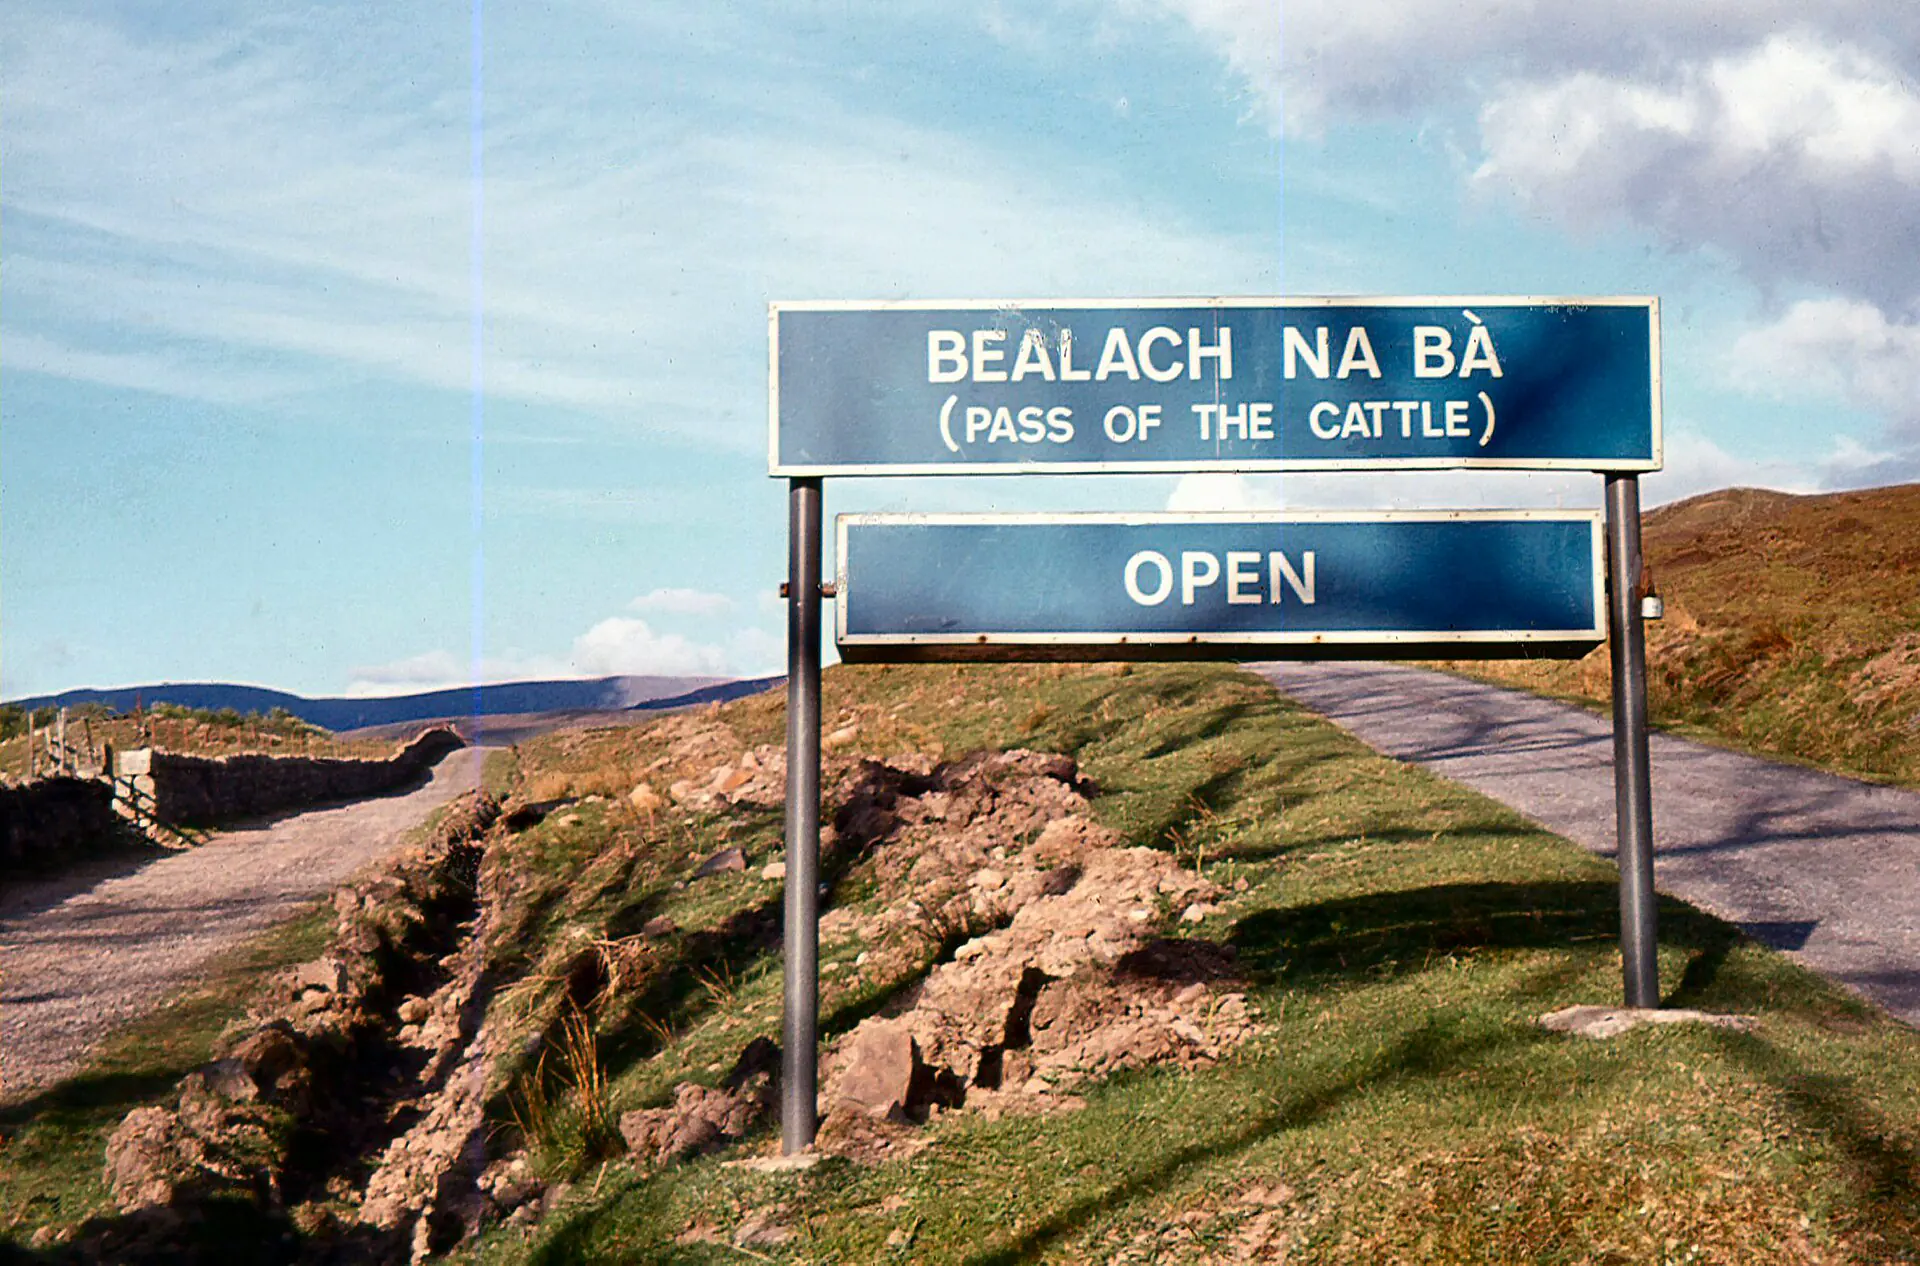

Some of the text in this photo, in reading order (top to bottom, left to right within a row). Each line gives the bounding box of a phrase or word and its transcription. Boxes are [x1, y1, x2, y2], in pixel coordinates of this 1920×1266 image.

[927, 309, 1504, 384] BEALACH NA BÀ
[1103, 405, 1163, 445] OF
[1192, 402, 1275, 442] THE
[1123, 550, 1317, 607] OPEN
